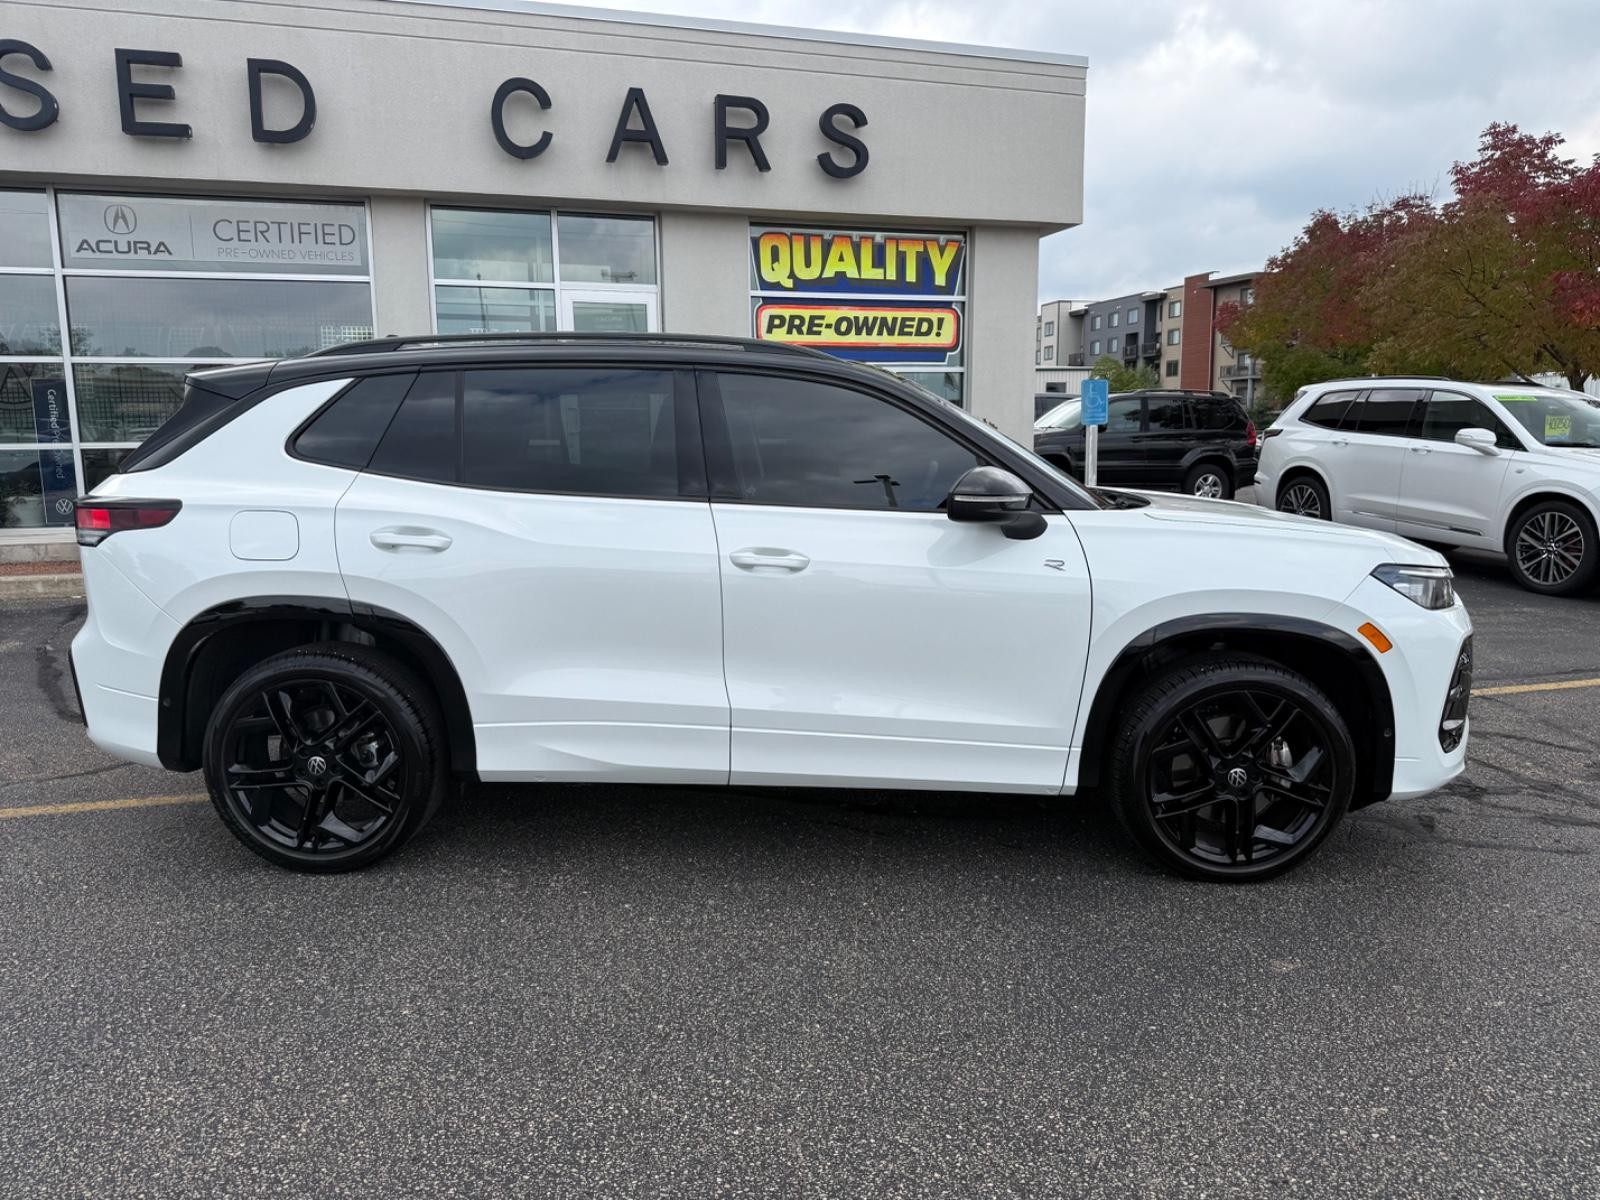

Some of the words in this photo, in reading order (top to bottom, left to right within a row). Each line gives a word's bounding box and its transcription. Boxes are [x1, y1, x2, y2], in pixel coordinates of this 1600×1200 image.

[491, 77, 869, 179] CARS
[213, 219, 356, 246] CERTIFIED
[76, 239, 173, 256] ACURA
[217, 247, 296, 260] PRE-OWNED
[299, 250, 355, 261] VEHICLES
[758, 231, 961, 289] QUALITY
[765, 314, 945, 338] PRE-OWNED!
[47, 389, 60, 429] Certified
[1043, 559, 1066, 571] R
